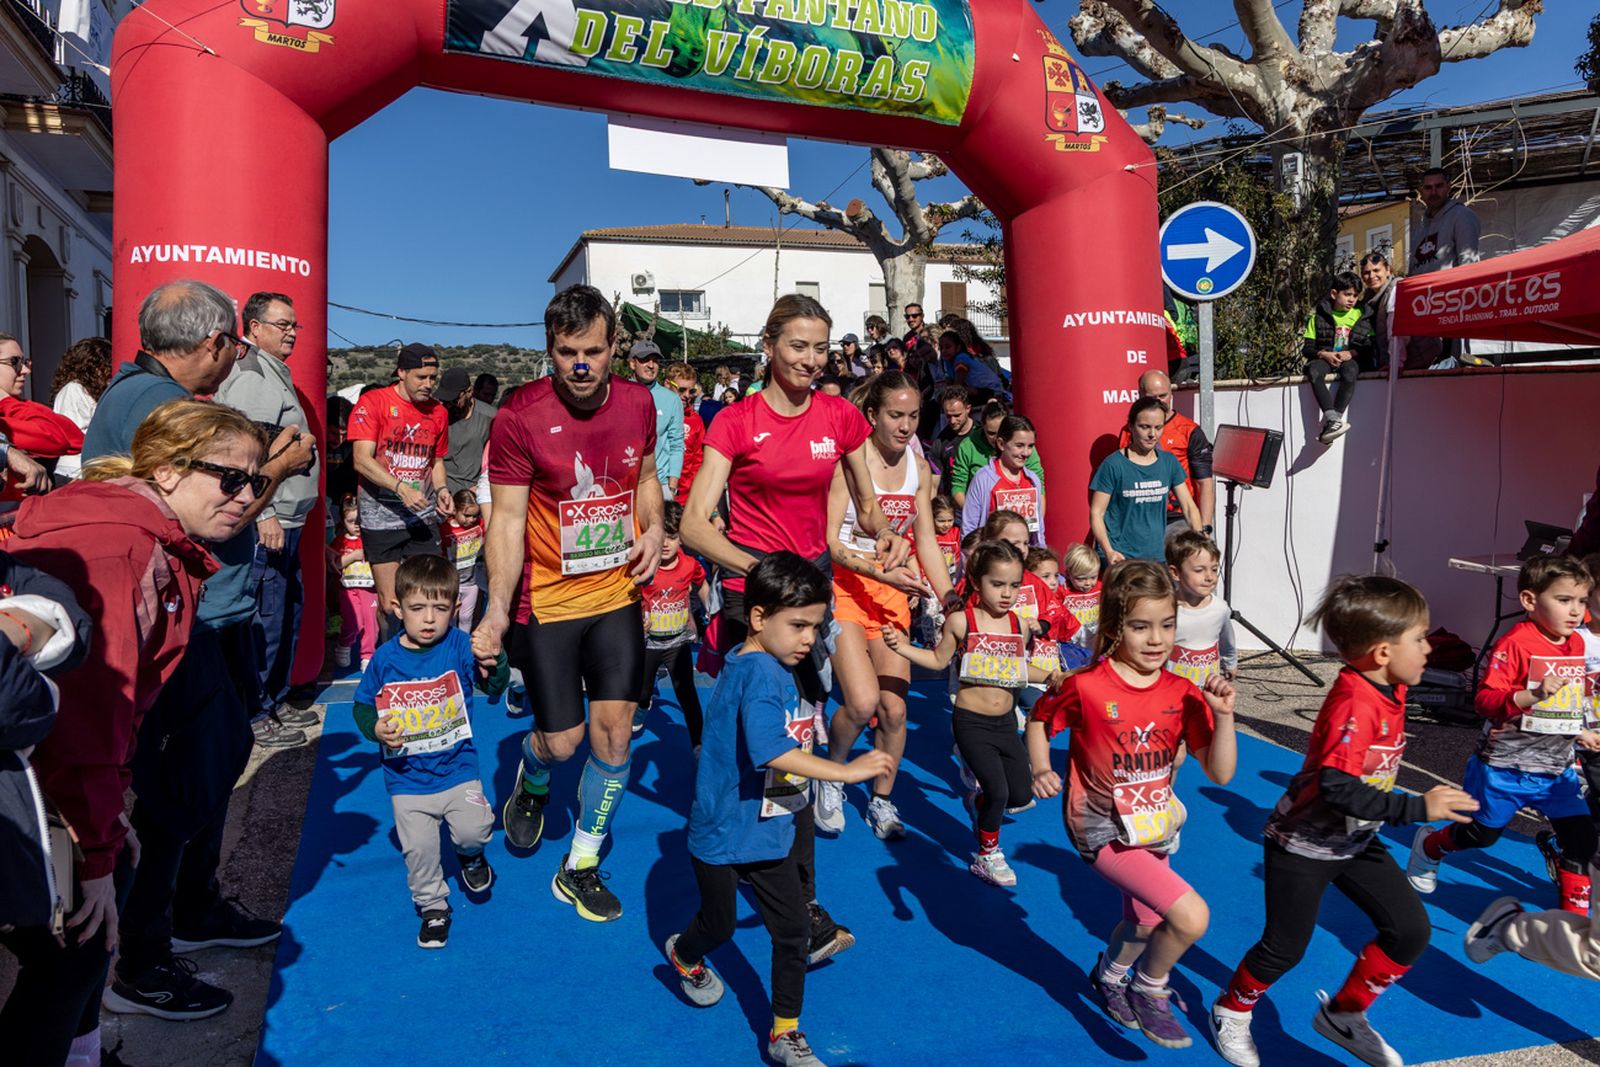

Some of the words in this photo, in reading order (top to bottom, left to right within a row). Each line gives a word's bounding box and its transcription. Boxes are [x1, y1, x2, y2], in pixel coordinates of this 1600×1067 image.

[267, 34, 307, 49] MARTOS
[569, 8, 674, 69] DEL
[703, 26, 931, 103] VÍBORAS
[1064, 143, 1092, 151] MARTOS
[130, 244, 311, 277] AYUNTAMIENTO
[1063, 311, 1166, 329] AYUNTAMIEN
[1464, 311, 1495, 323] RUNNING
[1499, 309, 1518, 318] TRAIL
[1524, 303, 1560, 315] OUTDOOR
[1126, 350, 1147, 364] DE
[1103, 389, 1141, 404] MAR
[573, 503, 586, 518] X
[587, 502, 624, 518] CROSS
[881, 499, 911, 509] CROSS
[575, 519, 625, 551] 424
[651, 600, 661, 610] X
[662, 599, 686, 611] CROSS
[976, 635, 988, 649] X
[988, 641, 1018, 652] CROSS
[1035, 642, 1045, 653] X
[1180, 649, 1191, 661] X
[1191, 650, 1216, 662] CROSS
[968, 655, 1022, 679] 5021
[1544, 662, 1557, 676] X
[1557, 665, 1585, 678] CROSS
[388, 687, 402, 702] X
[404, 684, 448, 702] CROSS
[386, 697, 458, 734] 5024
[1128, 786, 1148, 806] X
[590, 778, 623, 836] kalenji
